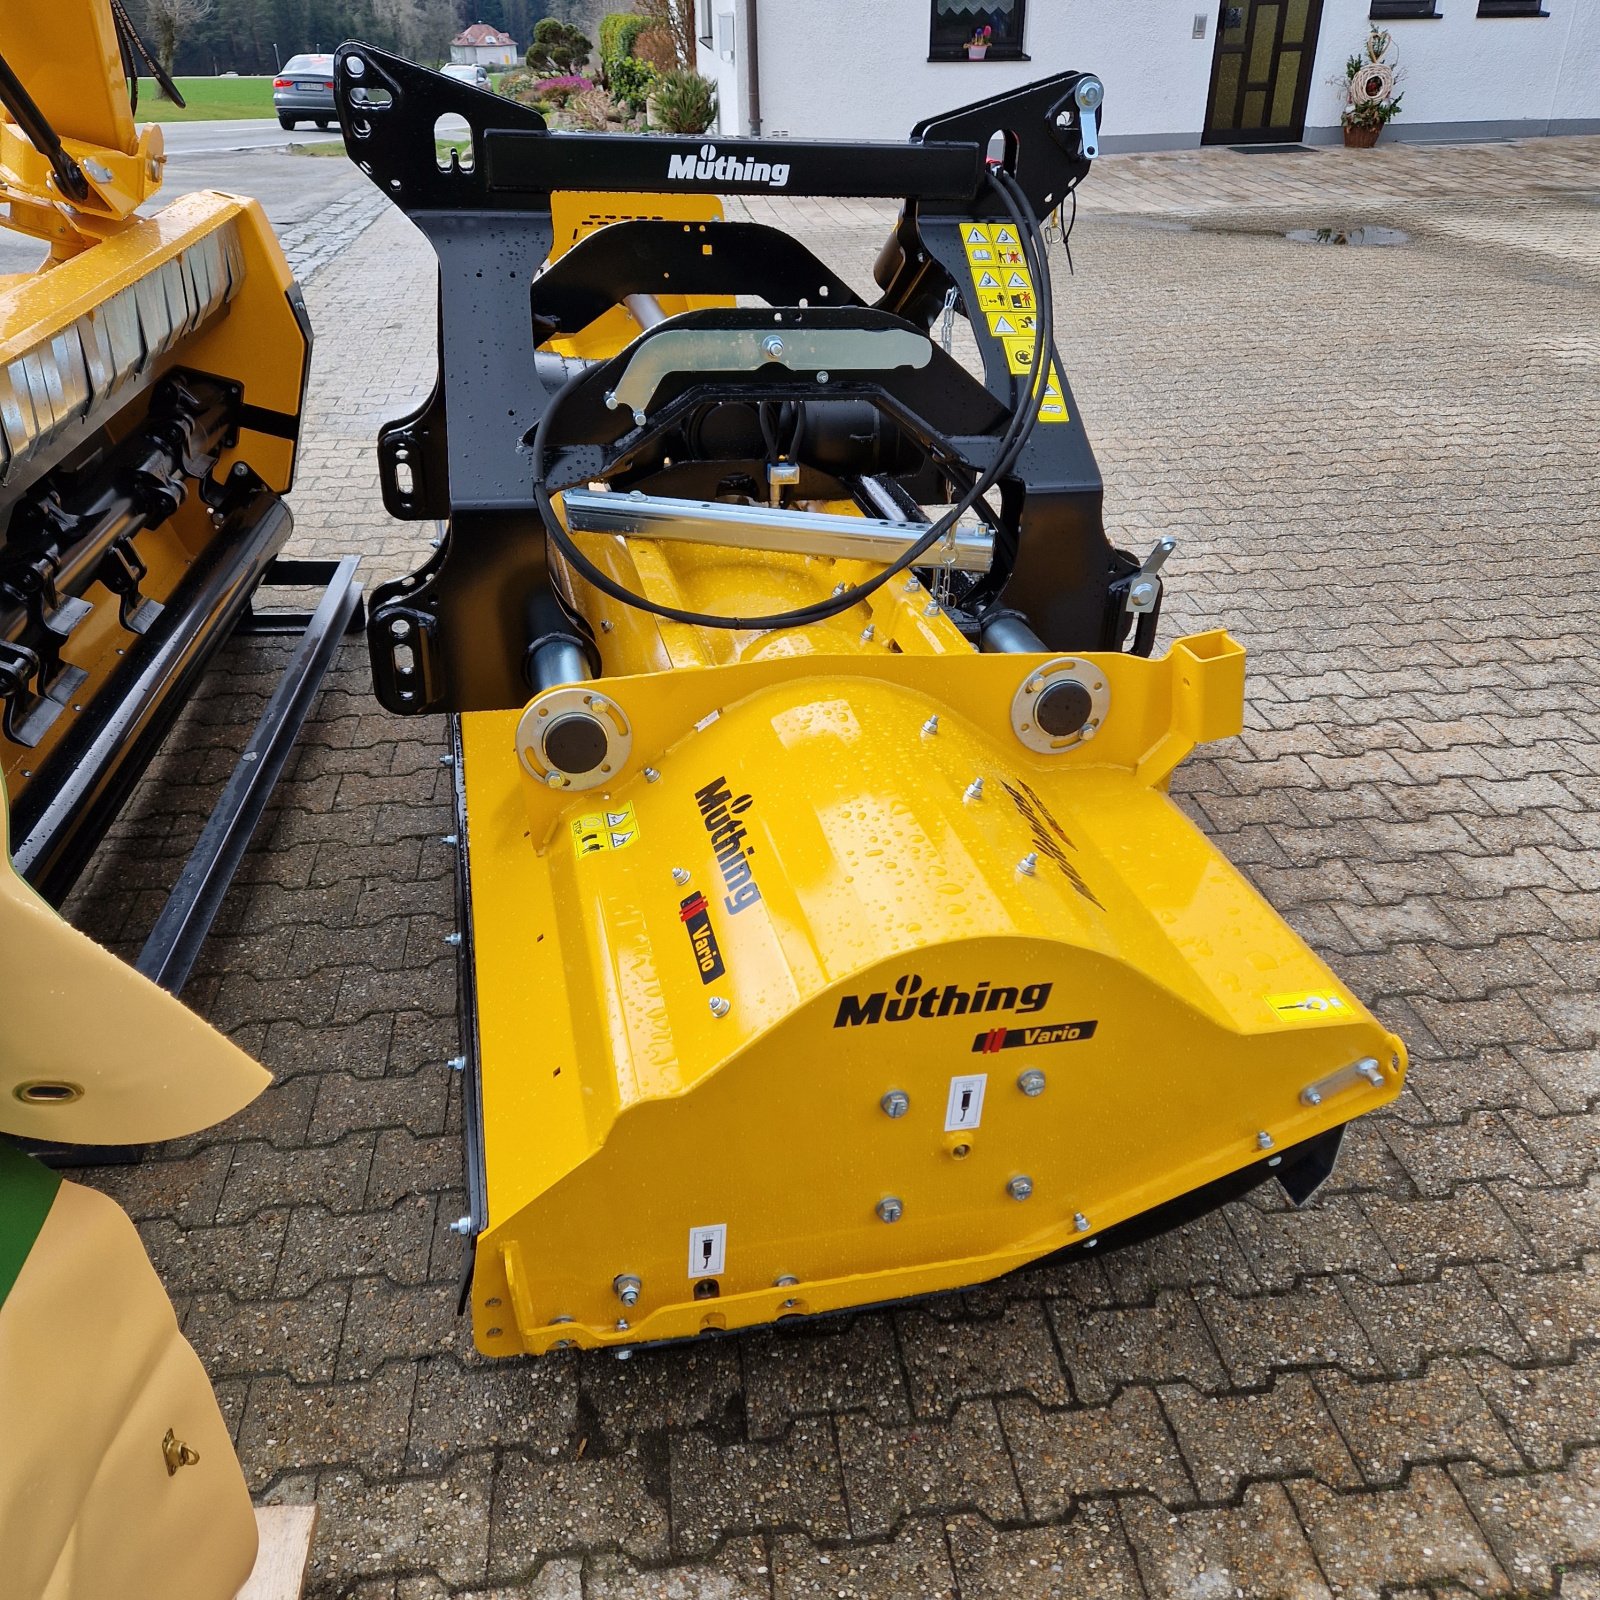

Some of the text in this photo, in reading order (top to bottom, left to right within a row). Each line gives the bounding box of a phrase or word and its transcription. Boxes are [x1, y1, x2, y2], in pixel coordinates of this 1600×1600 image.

[667, 144, 790, 187] Müthing
[693, 923, 717, 972] Vario
[833, 974, 1053, 1028] Müthing
[1024, 1025, 1081, 1045] Vario
